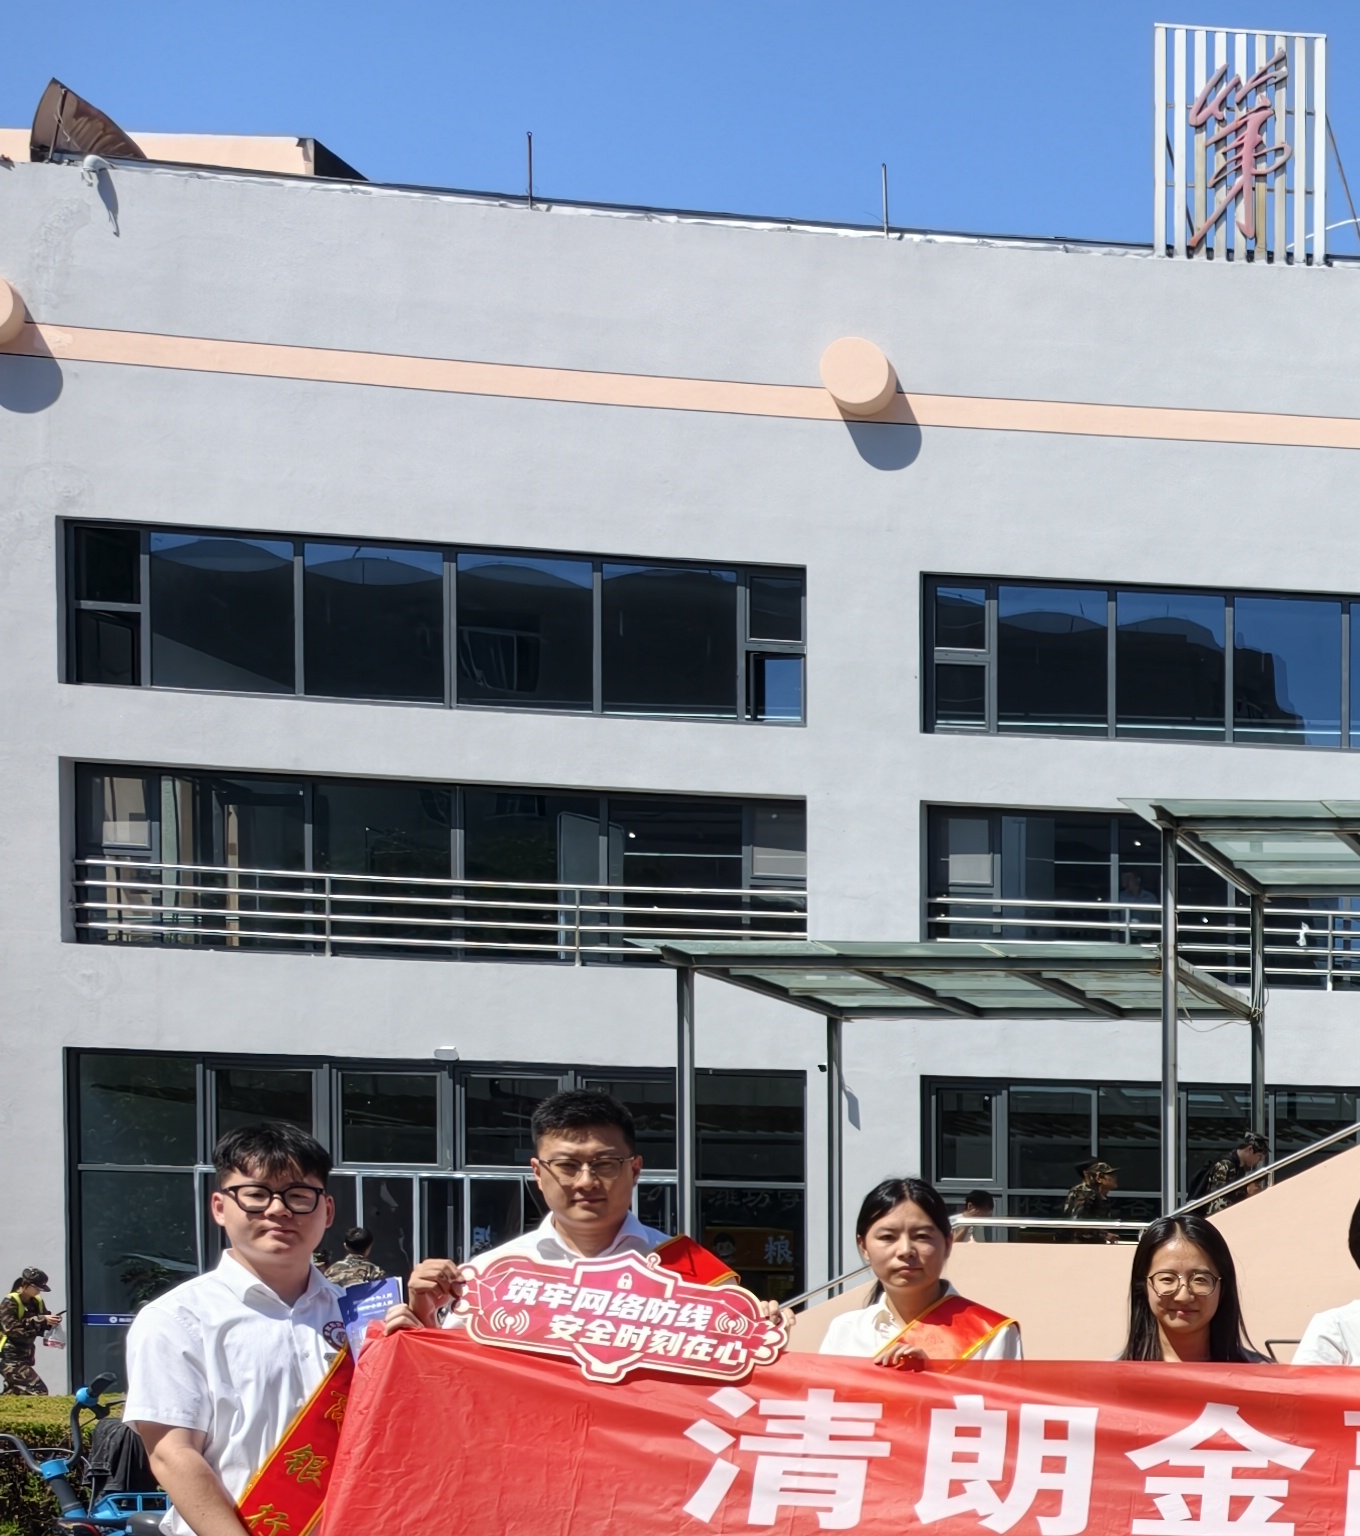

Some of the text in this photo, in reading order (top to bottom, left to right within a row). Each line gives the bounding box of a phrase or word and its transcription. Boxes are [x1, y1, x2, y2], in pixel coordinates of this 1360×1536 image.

[502, 1275, 714, 1331] 筑牢网络防线
[544, 1314, 748, 1366] 安全时刻在心
